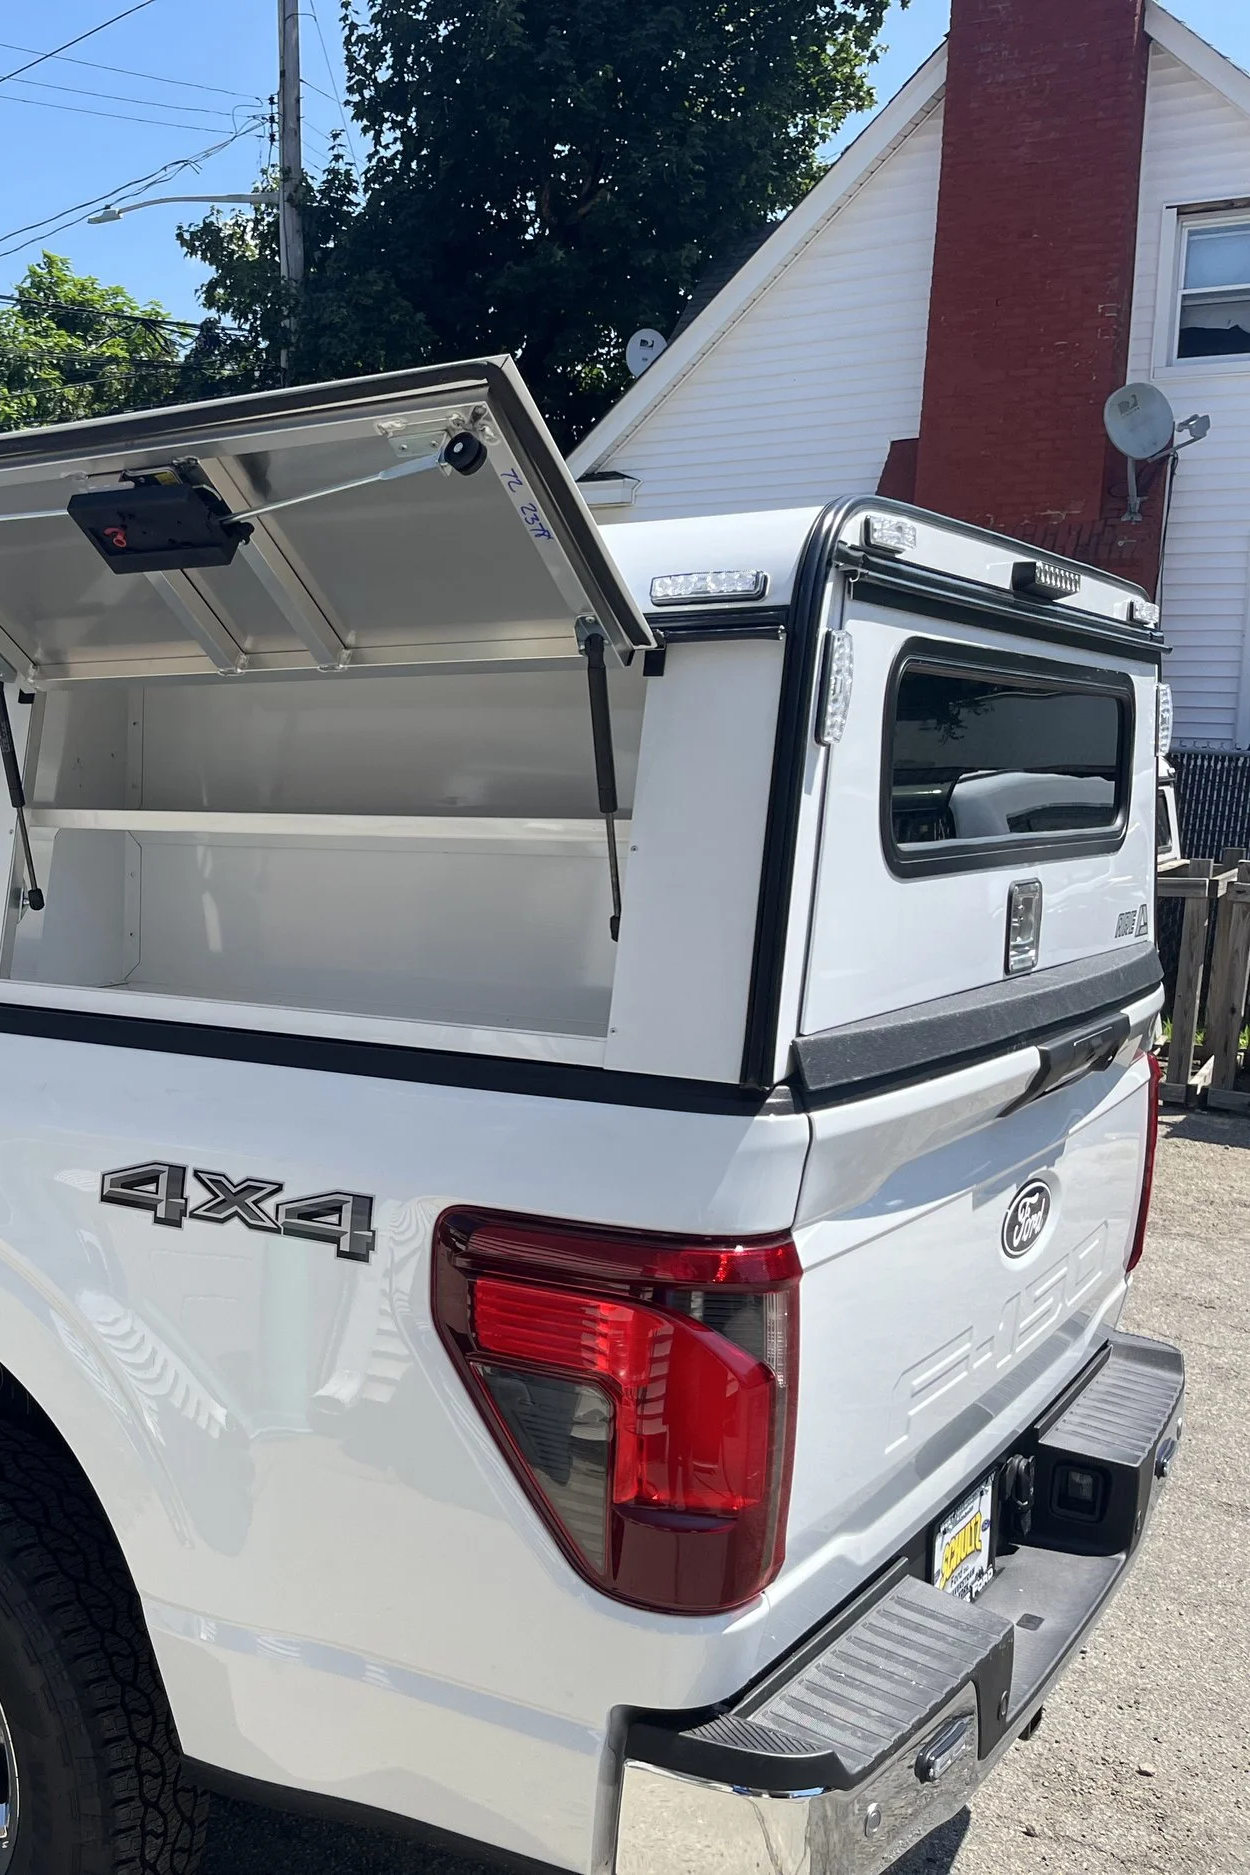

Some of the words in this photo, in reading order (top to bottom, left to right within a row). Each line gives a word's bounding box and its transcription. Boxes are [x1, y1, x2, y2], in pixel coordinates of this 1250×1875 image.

[1011, 1190, 1048, 1248] Ford
[939, 1511, 982, 1591] SCHULTZ
[971, 1567, 994, 1599] FORD
